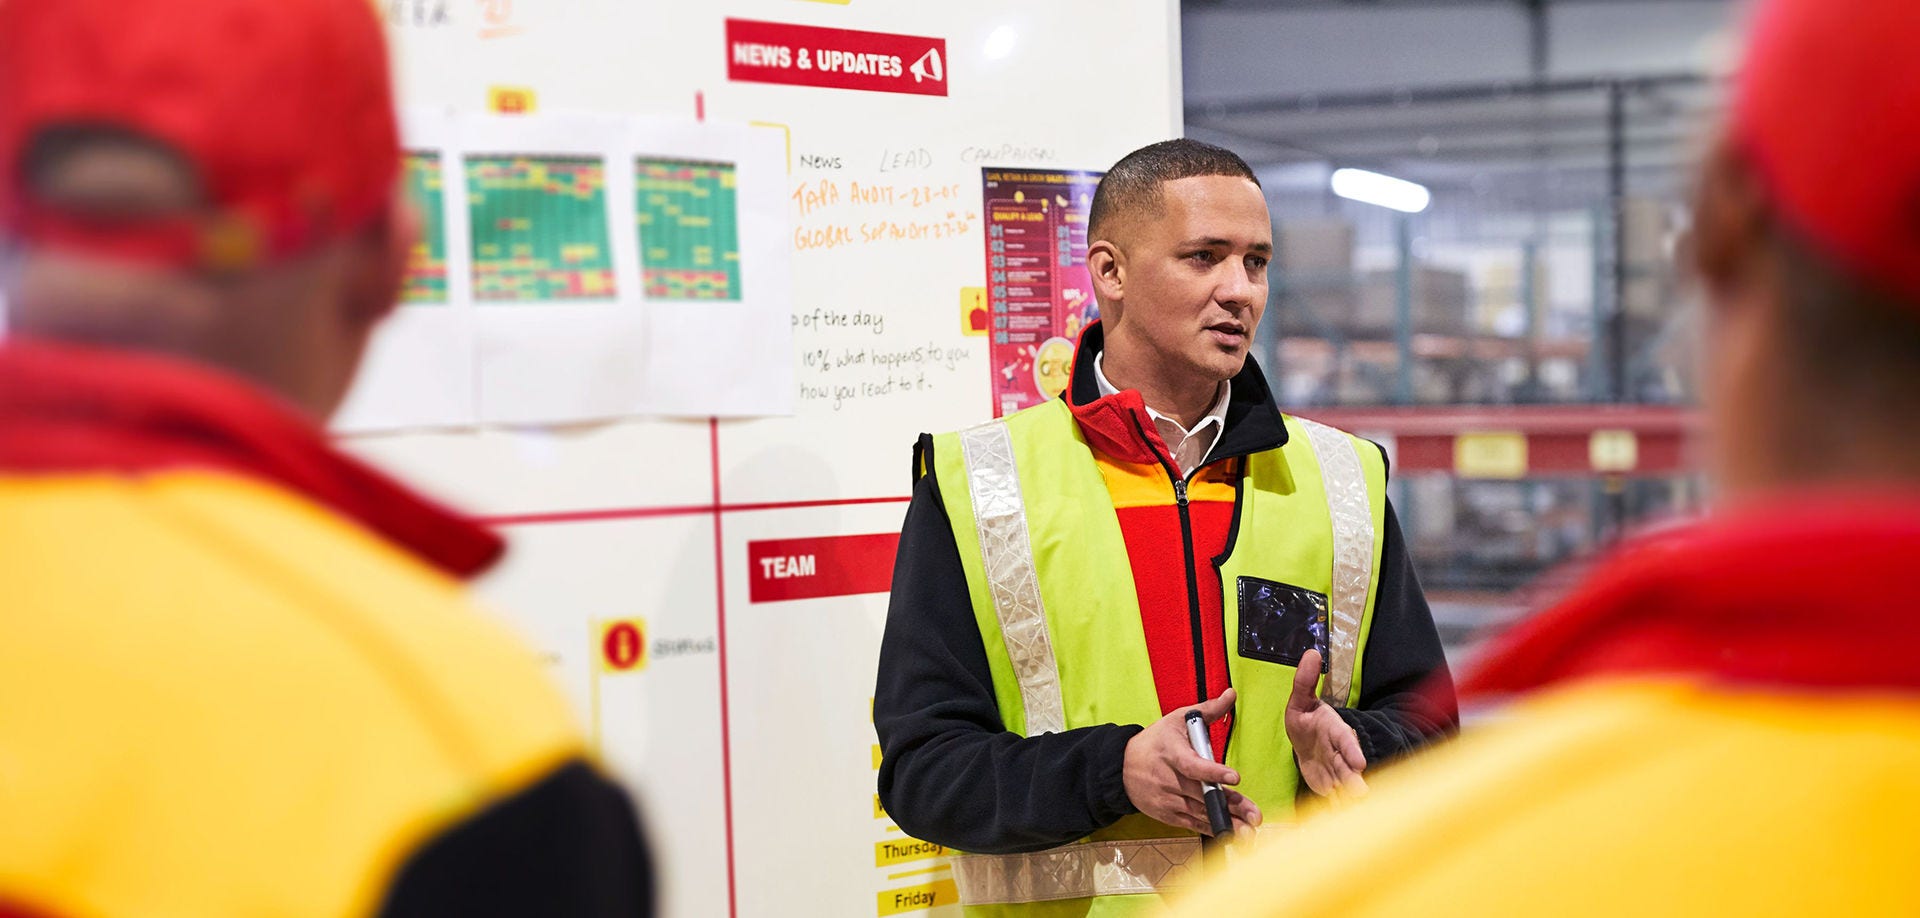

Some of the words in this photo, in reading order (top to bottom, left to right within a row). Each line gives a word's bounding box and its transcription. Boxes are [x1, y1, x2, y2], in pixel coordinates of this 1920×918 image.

[733, 42, 791, 68] NEWS
[796, 48, 812, 70] &
[817, 49, 903, 78] UPDATES
[800, 154, 842, 169] News
[880, 148, 933, 173] LEAD
[792, 178, 839, 217] TAPA
[850, 181, 895, 205] AUDIT
[794, 223, 853, 250] GLOBAL
[990, 224, 1003, 237] 01
[991, 240, 1005, 252] 02
[992, 255, 1005, 268] 03
[993, 270, 1006, 283] 04
[803, 308, 821, 333] of
[824, 311, 848, 327] the
[853, 310, 884, 335] day
[995, 316, 1008, 329] 07
[802, 348, 831, 373] 10%
[836, 348, 866, 368] what
[928, 341, 943, 361] to
[946, 347, 970, 372] you
[800, 382, 829, 400] how
[833, 385, 856, 411] you
[861, 376, 895, 397] react
[899, 377, 912, 391] to
[760, 554, 816, 579] TEAM
[884, 841, 944, 859] Thursday
[896, 890, 937, 908] Friday
